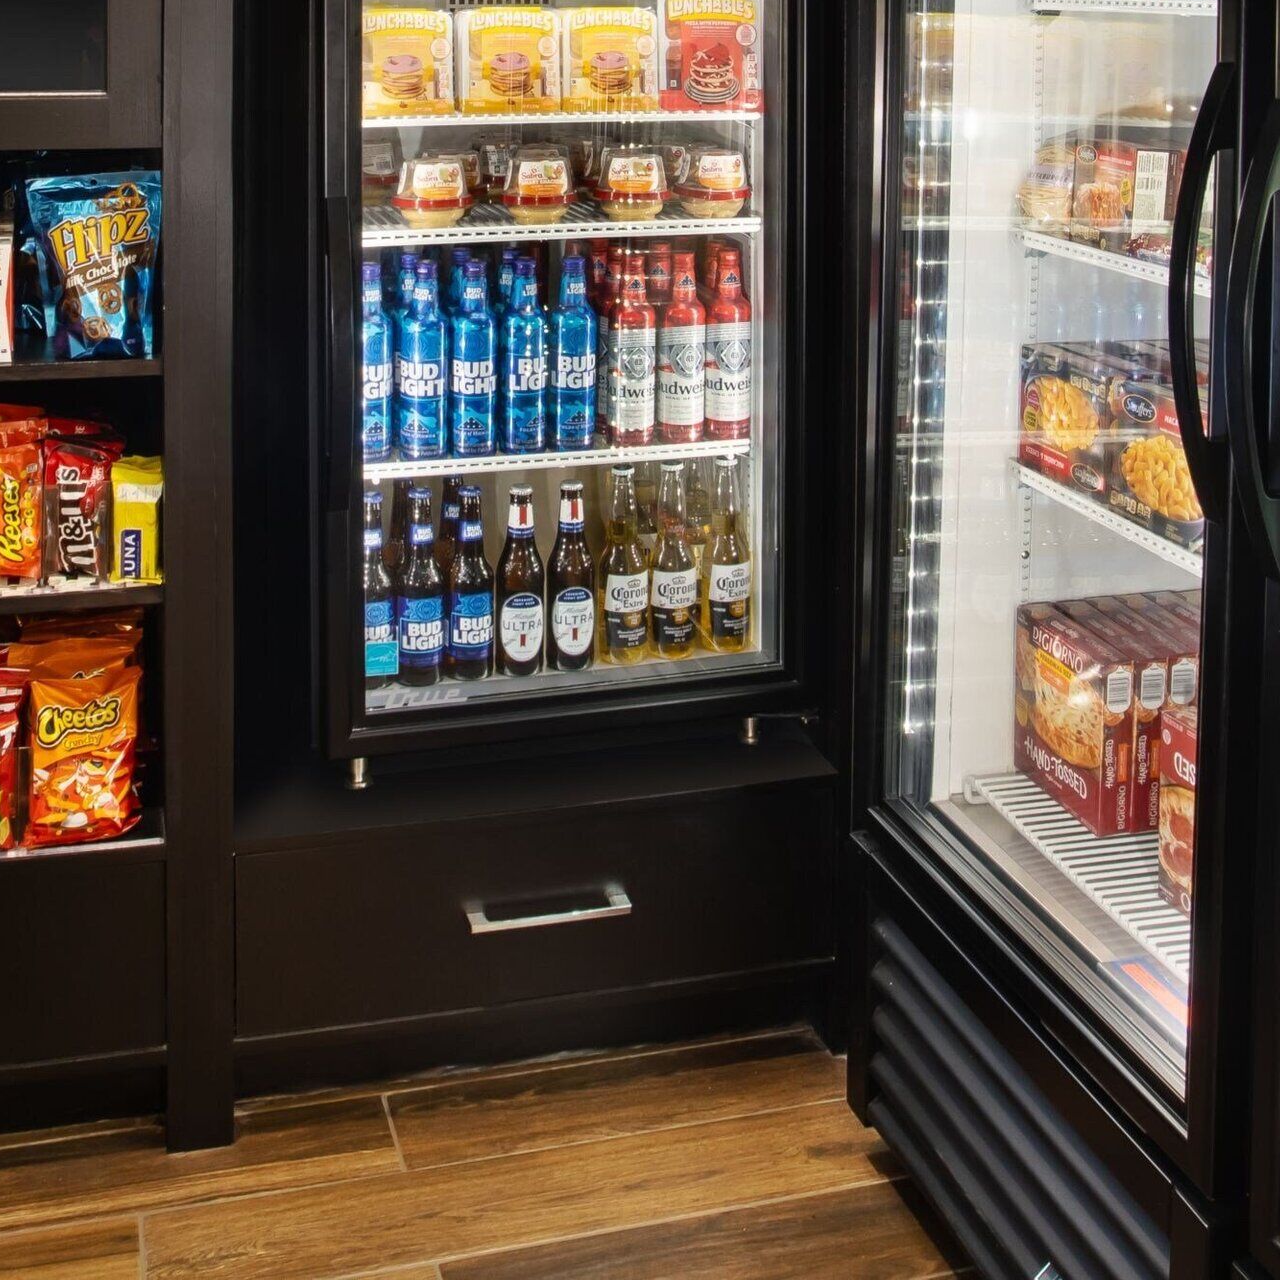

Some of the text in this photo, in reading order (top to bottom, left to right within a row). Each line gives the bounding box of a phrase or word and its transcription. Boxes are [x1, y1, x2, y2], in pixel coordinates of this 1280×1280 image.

[471, 11, 554, 33] LUNCHABLES
[571, 10, 652, 32] LUNCHABLES
[521, 171, 543, 180] Sabra
[48, 209, 151, 272] Flipz
[400, 362, 439, 380] BUD
[453, 360, 494, 378] BUD
[558, 355, 596, 371] BUD
[124, 534, 137, 579] LUNA
[623, 600, 644, 609] Extra
[670, 595, 691, 605] Extra
[408, 621, 441, 636] BUD
[460, 616, 492, 631] BUD
[503, 619, 542, 632] ULTRA
[554, 612, 593, 626] ULTRA
[402, 634, 444, 650] LIGHT
[1032, 625, 1084, 674] DIGIORNO
[36, 695, 122, 748] Cheetos
[1024, 737, 1087, 800] HAND-TOSSED
[1104, 738, 1114, 789] HAND-TOSSED
[1138, 734, 1148, 785] HAND-TOSSED
[1117, 785, 1127, 830] DIGIORNO
[1149, 781, 1160, 827] DIGIORNO
